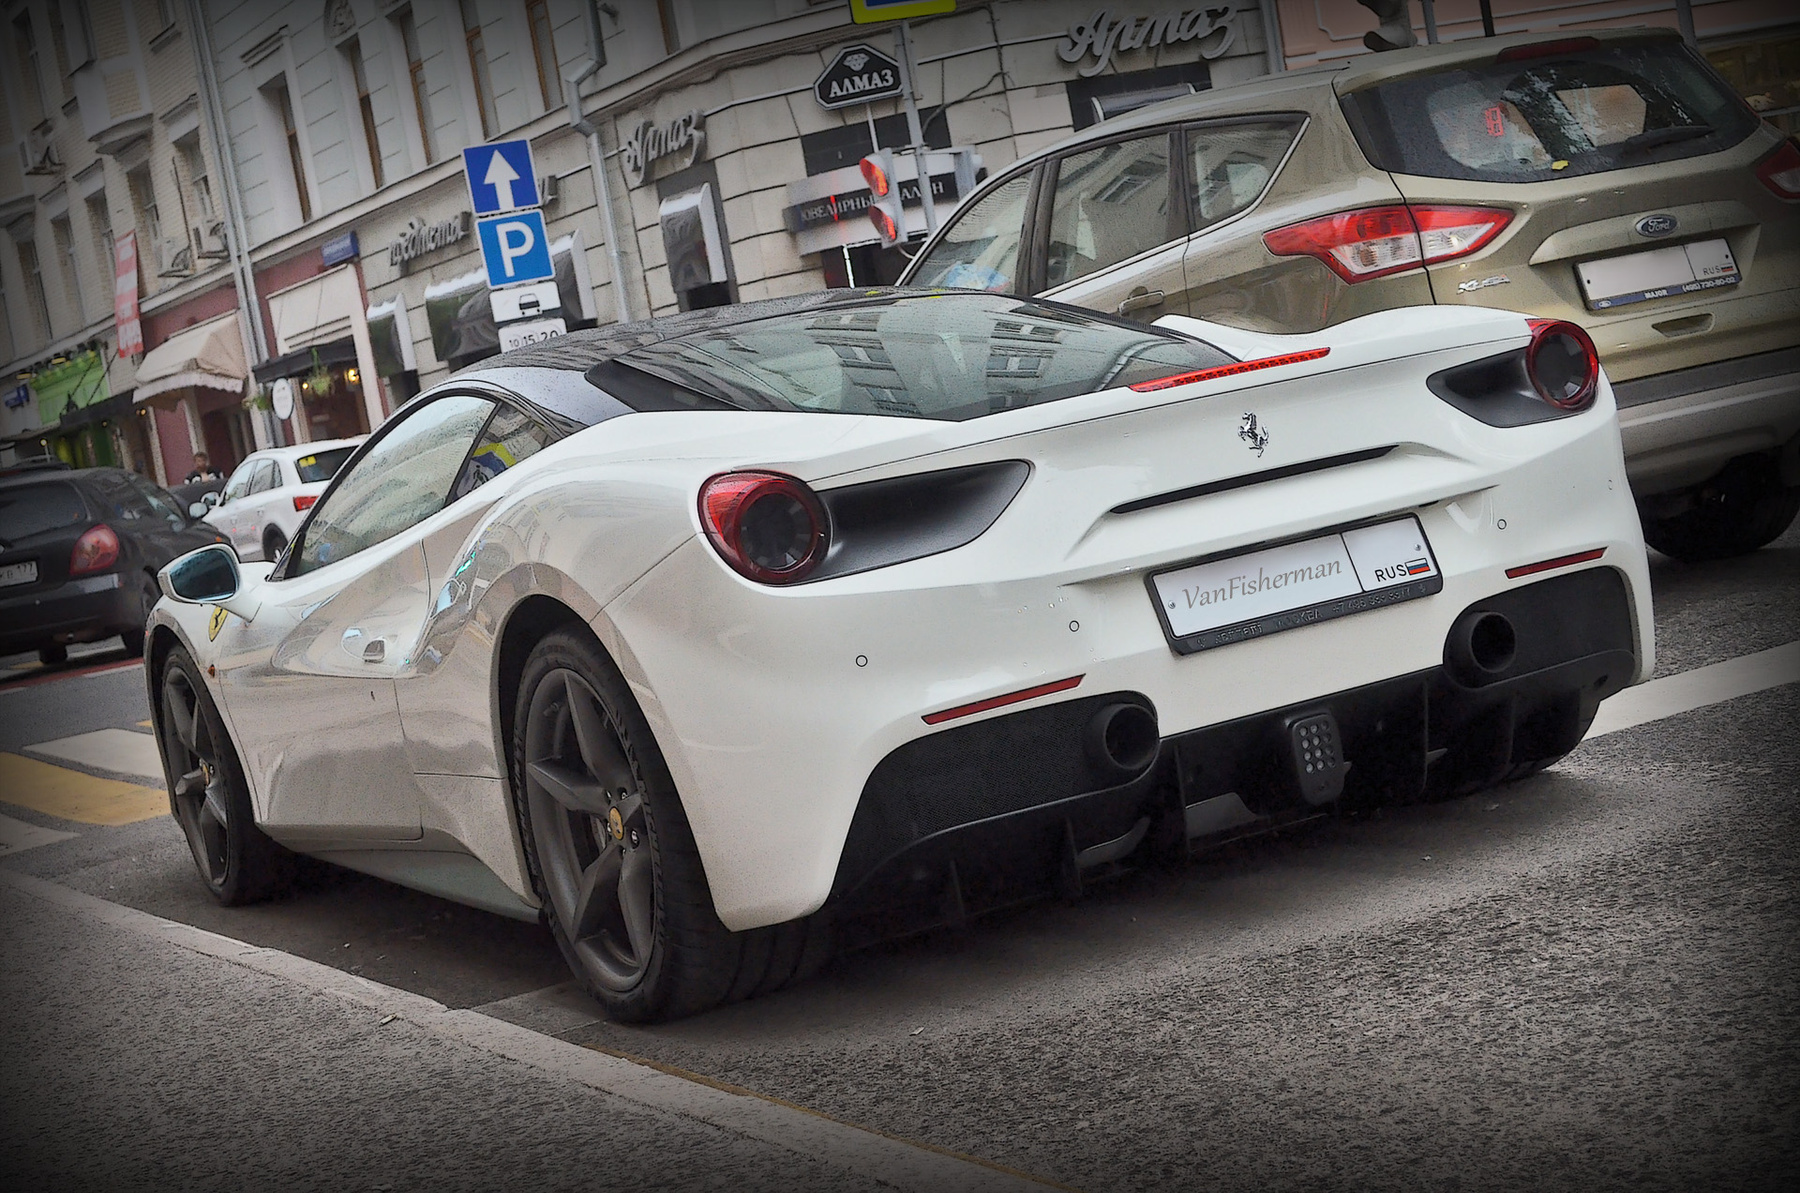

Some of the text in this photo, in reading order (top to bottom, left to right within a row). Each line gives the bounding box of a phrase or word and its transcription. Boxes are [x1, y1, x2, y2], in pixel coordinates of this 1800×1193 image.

[1057, 4, 1237, 77] Алмаз
[829, 68, 894, 98] АЛМАЗ
[1647, 217, 1671, 232] Ford
[495, 221, 535, 278] P
[1703, 265, 1720, 276] RUS
[1374, 564, 1407, 583] RUS
